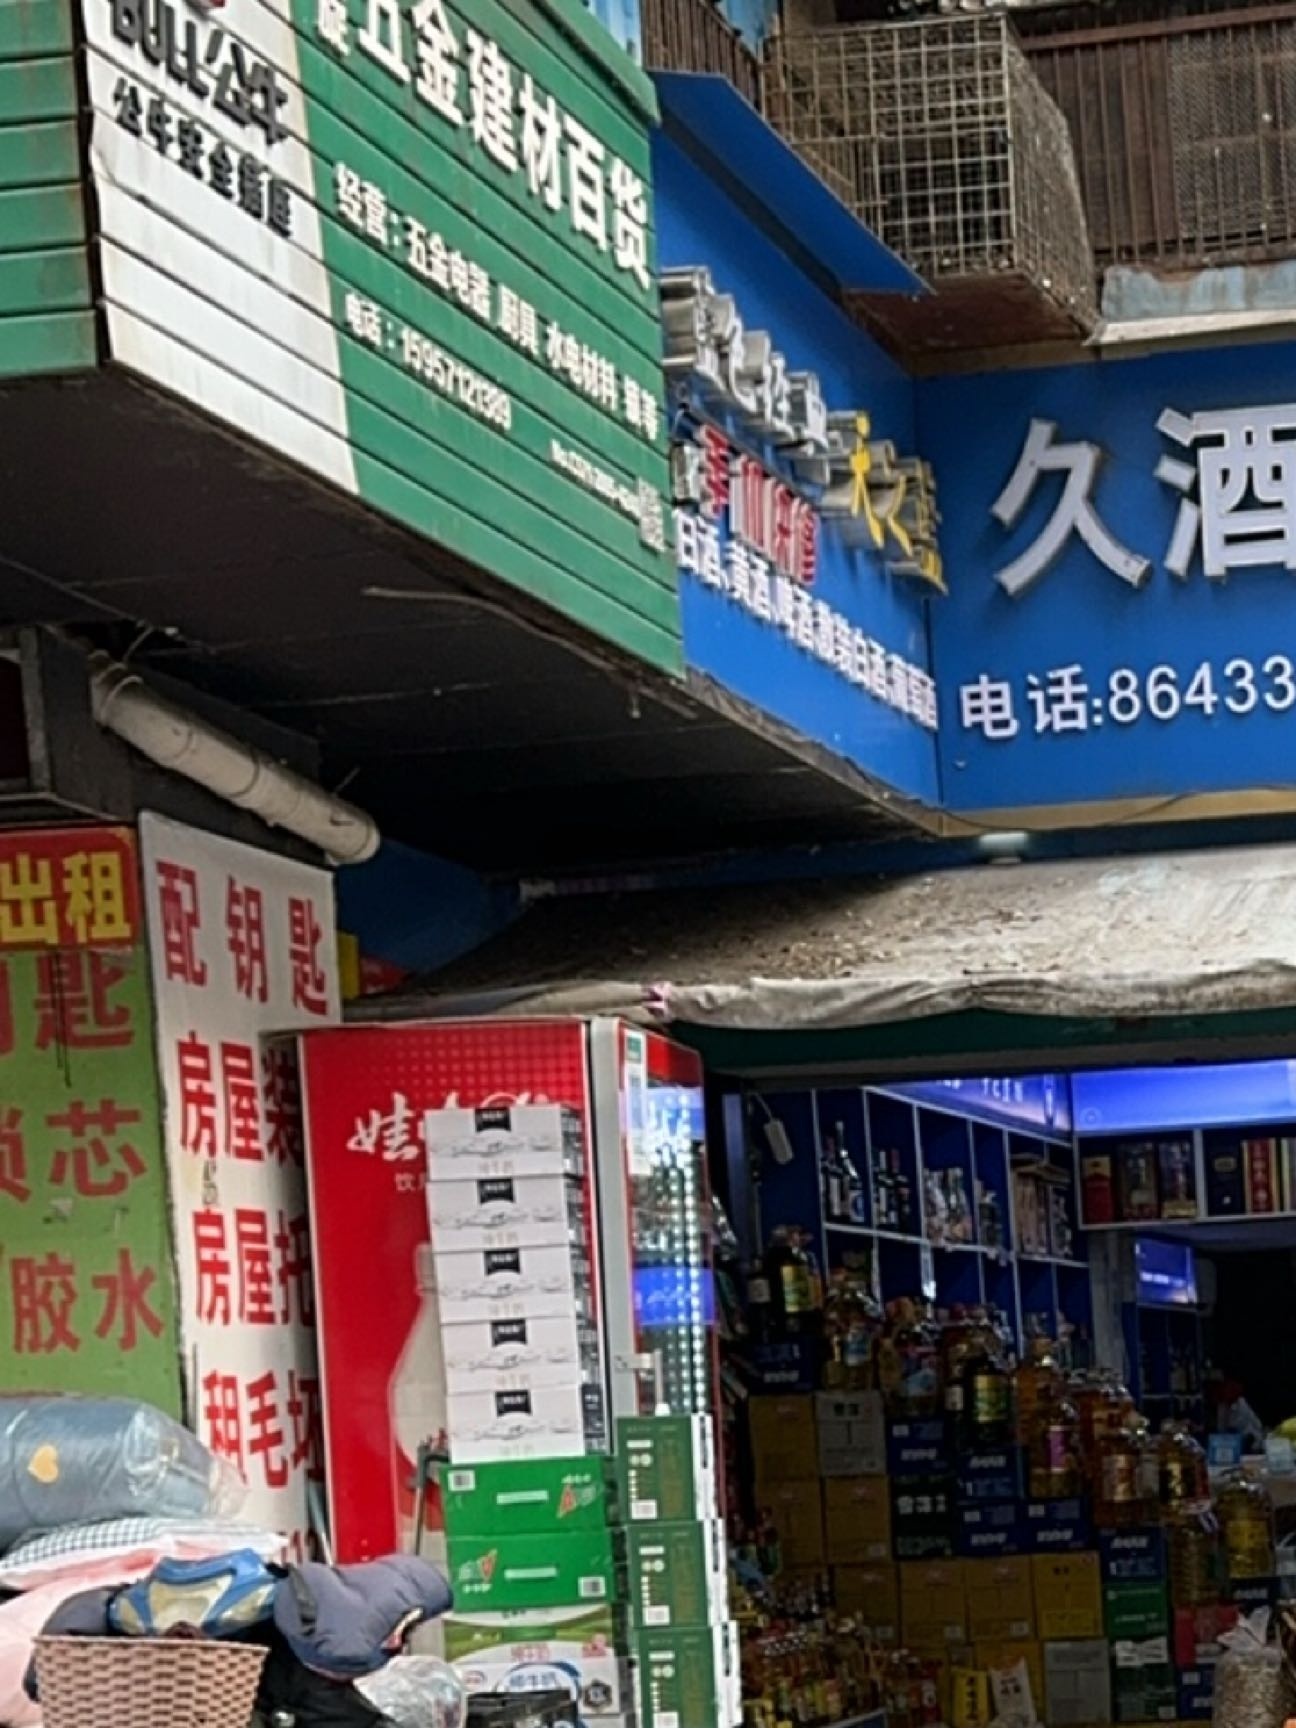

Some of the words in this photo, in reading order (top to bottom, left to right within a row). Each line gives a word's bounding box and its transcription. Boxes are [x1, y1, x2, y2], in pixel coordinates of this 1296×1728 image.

[0, 850, 132, 945] 出租
[157, 859, 327, 1016] 配钥匙
[0, 952, 134, 1057] 匙
[10, 1247, 164, 1354] 胶水
